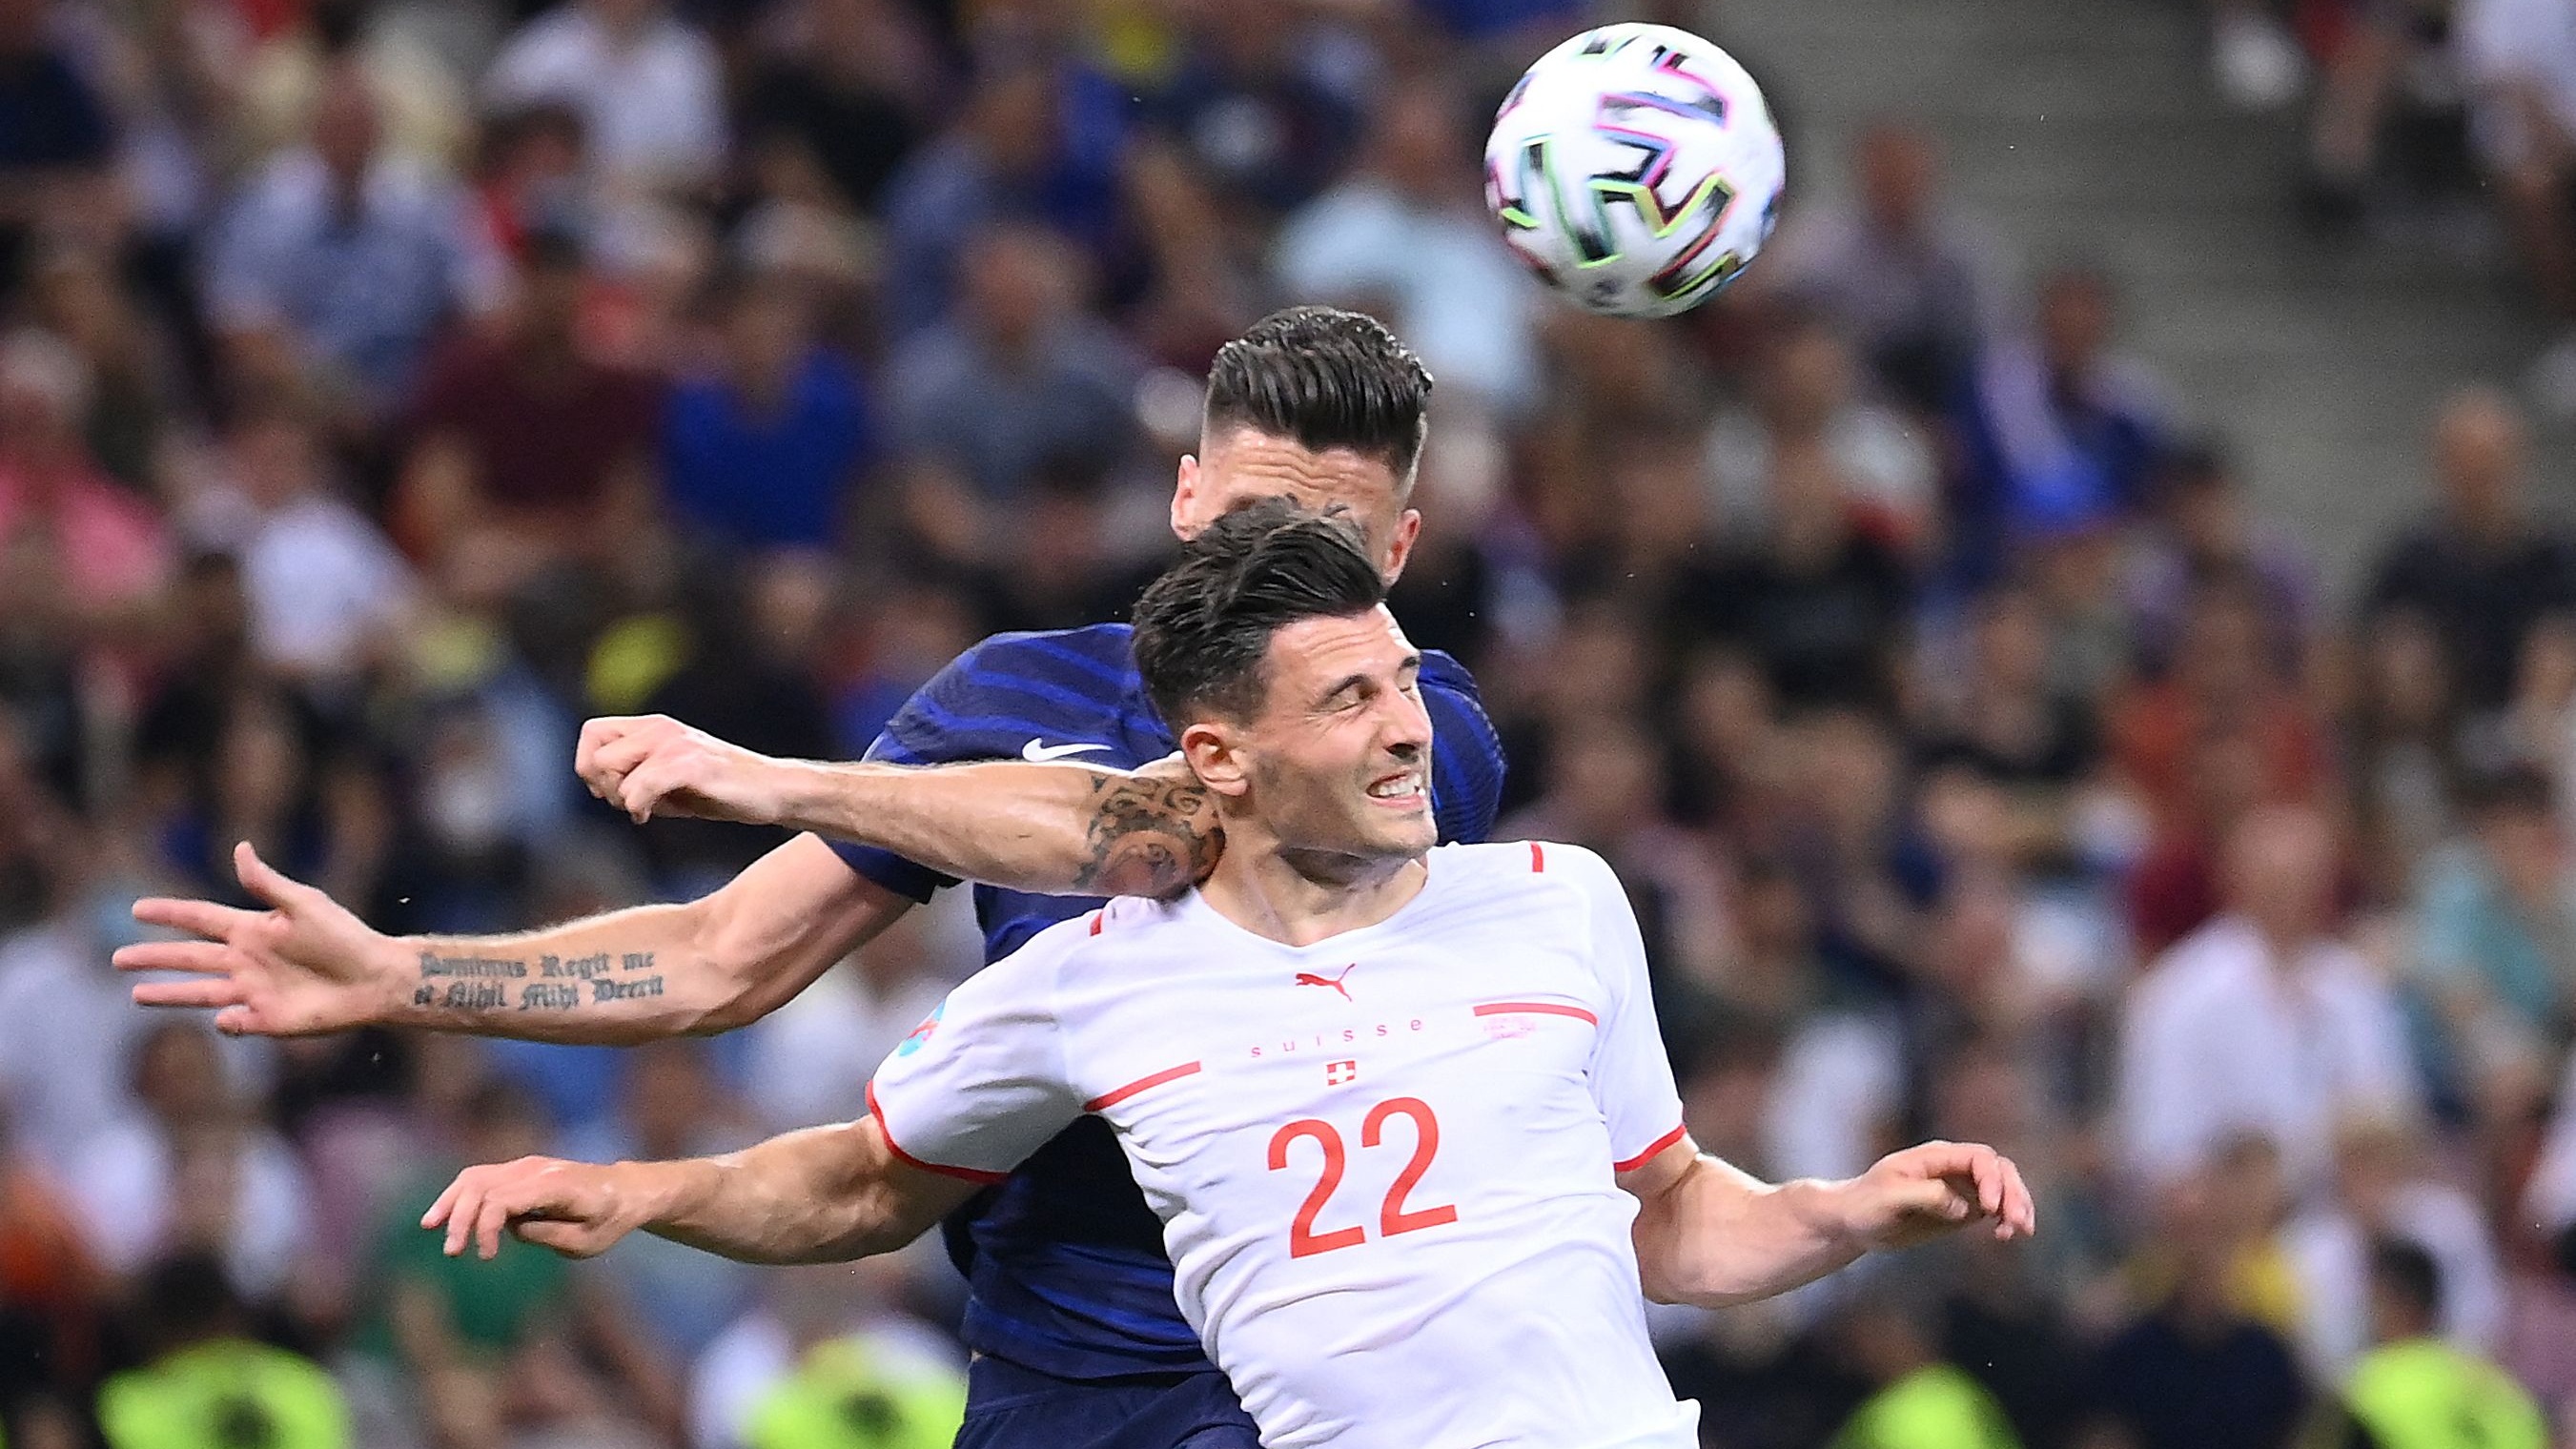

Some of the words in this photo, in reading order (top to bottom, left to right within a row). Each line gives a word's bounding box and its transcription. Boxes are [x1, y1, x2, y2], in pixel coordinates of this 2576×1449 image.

[624, 952, 654, 970] me
[1251, 1019, 1421, 1057] suisse
[1268, 1097, 1458, 1258] 22
